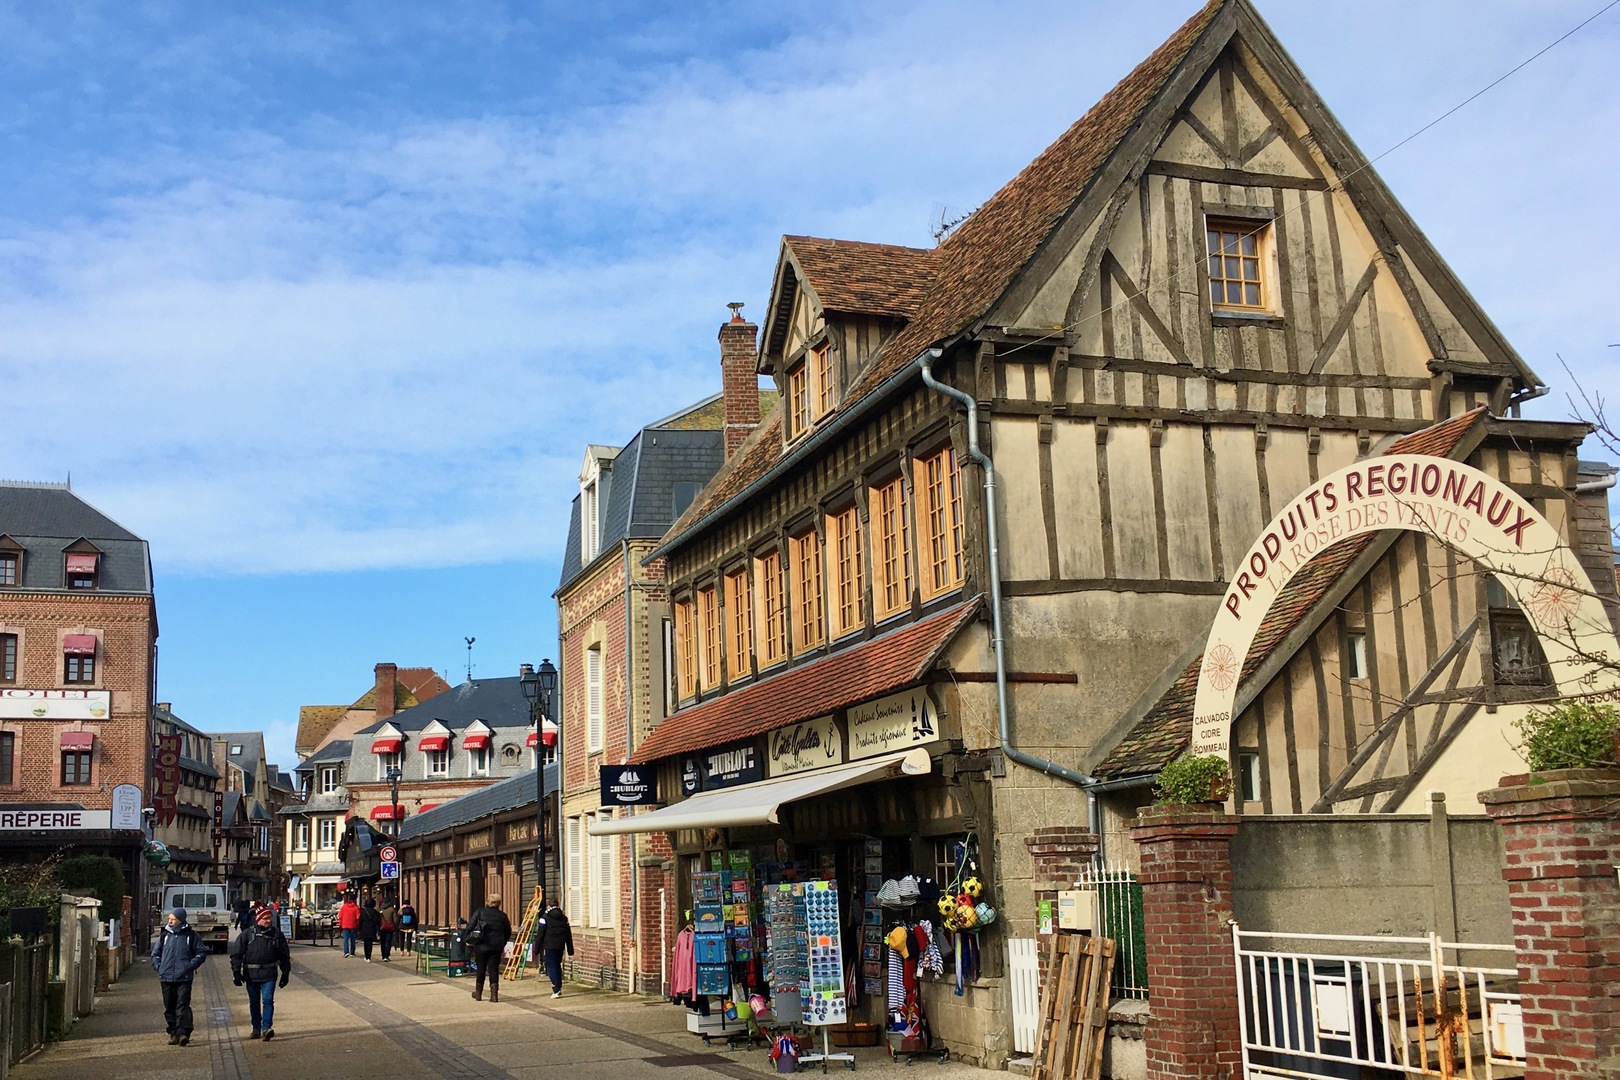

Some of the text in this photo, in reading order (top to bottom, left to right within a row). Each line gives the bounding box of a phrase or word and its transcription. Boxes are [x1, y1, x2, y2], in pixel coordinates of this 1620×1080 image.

[1225, 462, 1538, 621] PRODUITS REGIONAUX
[1266, 500, 1471, 595] LA ROSE DES VENTS
[1194, 711, 1230, 726] CALVADOS
[855, 731, 878, 750] Produits
[1200, 727, 1221, 739] CIDRE
[1194, 742, 1228, 755] POMMEAU
[712, 748, 748, 776] HUBLOT
[161, 738, 177, 809] HOTEL
[614, 785, 645, 793] HUBLOT
